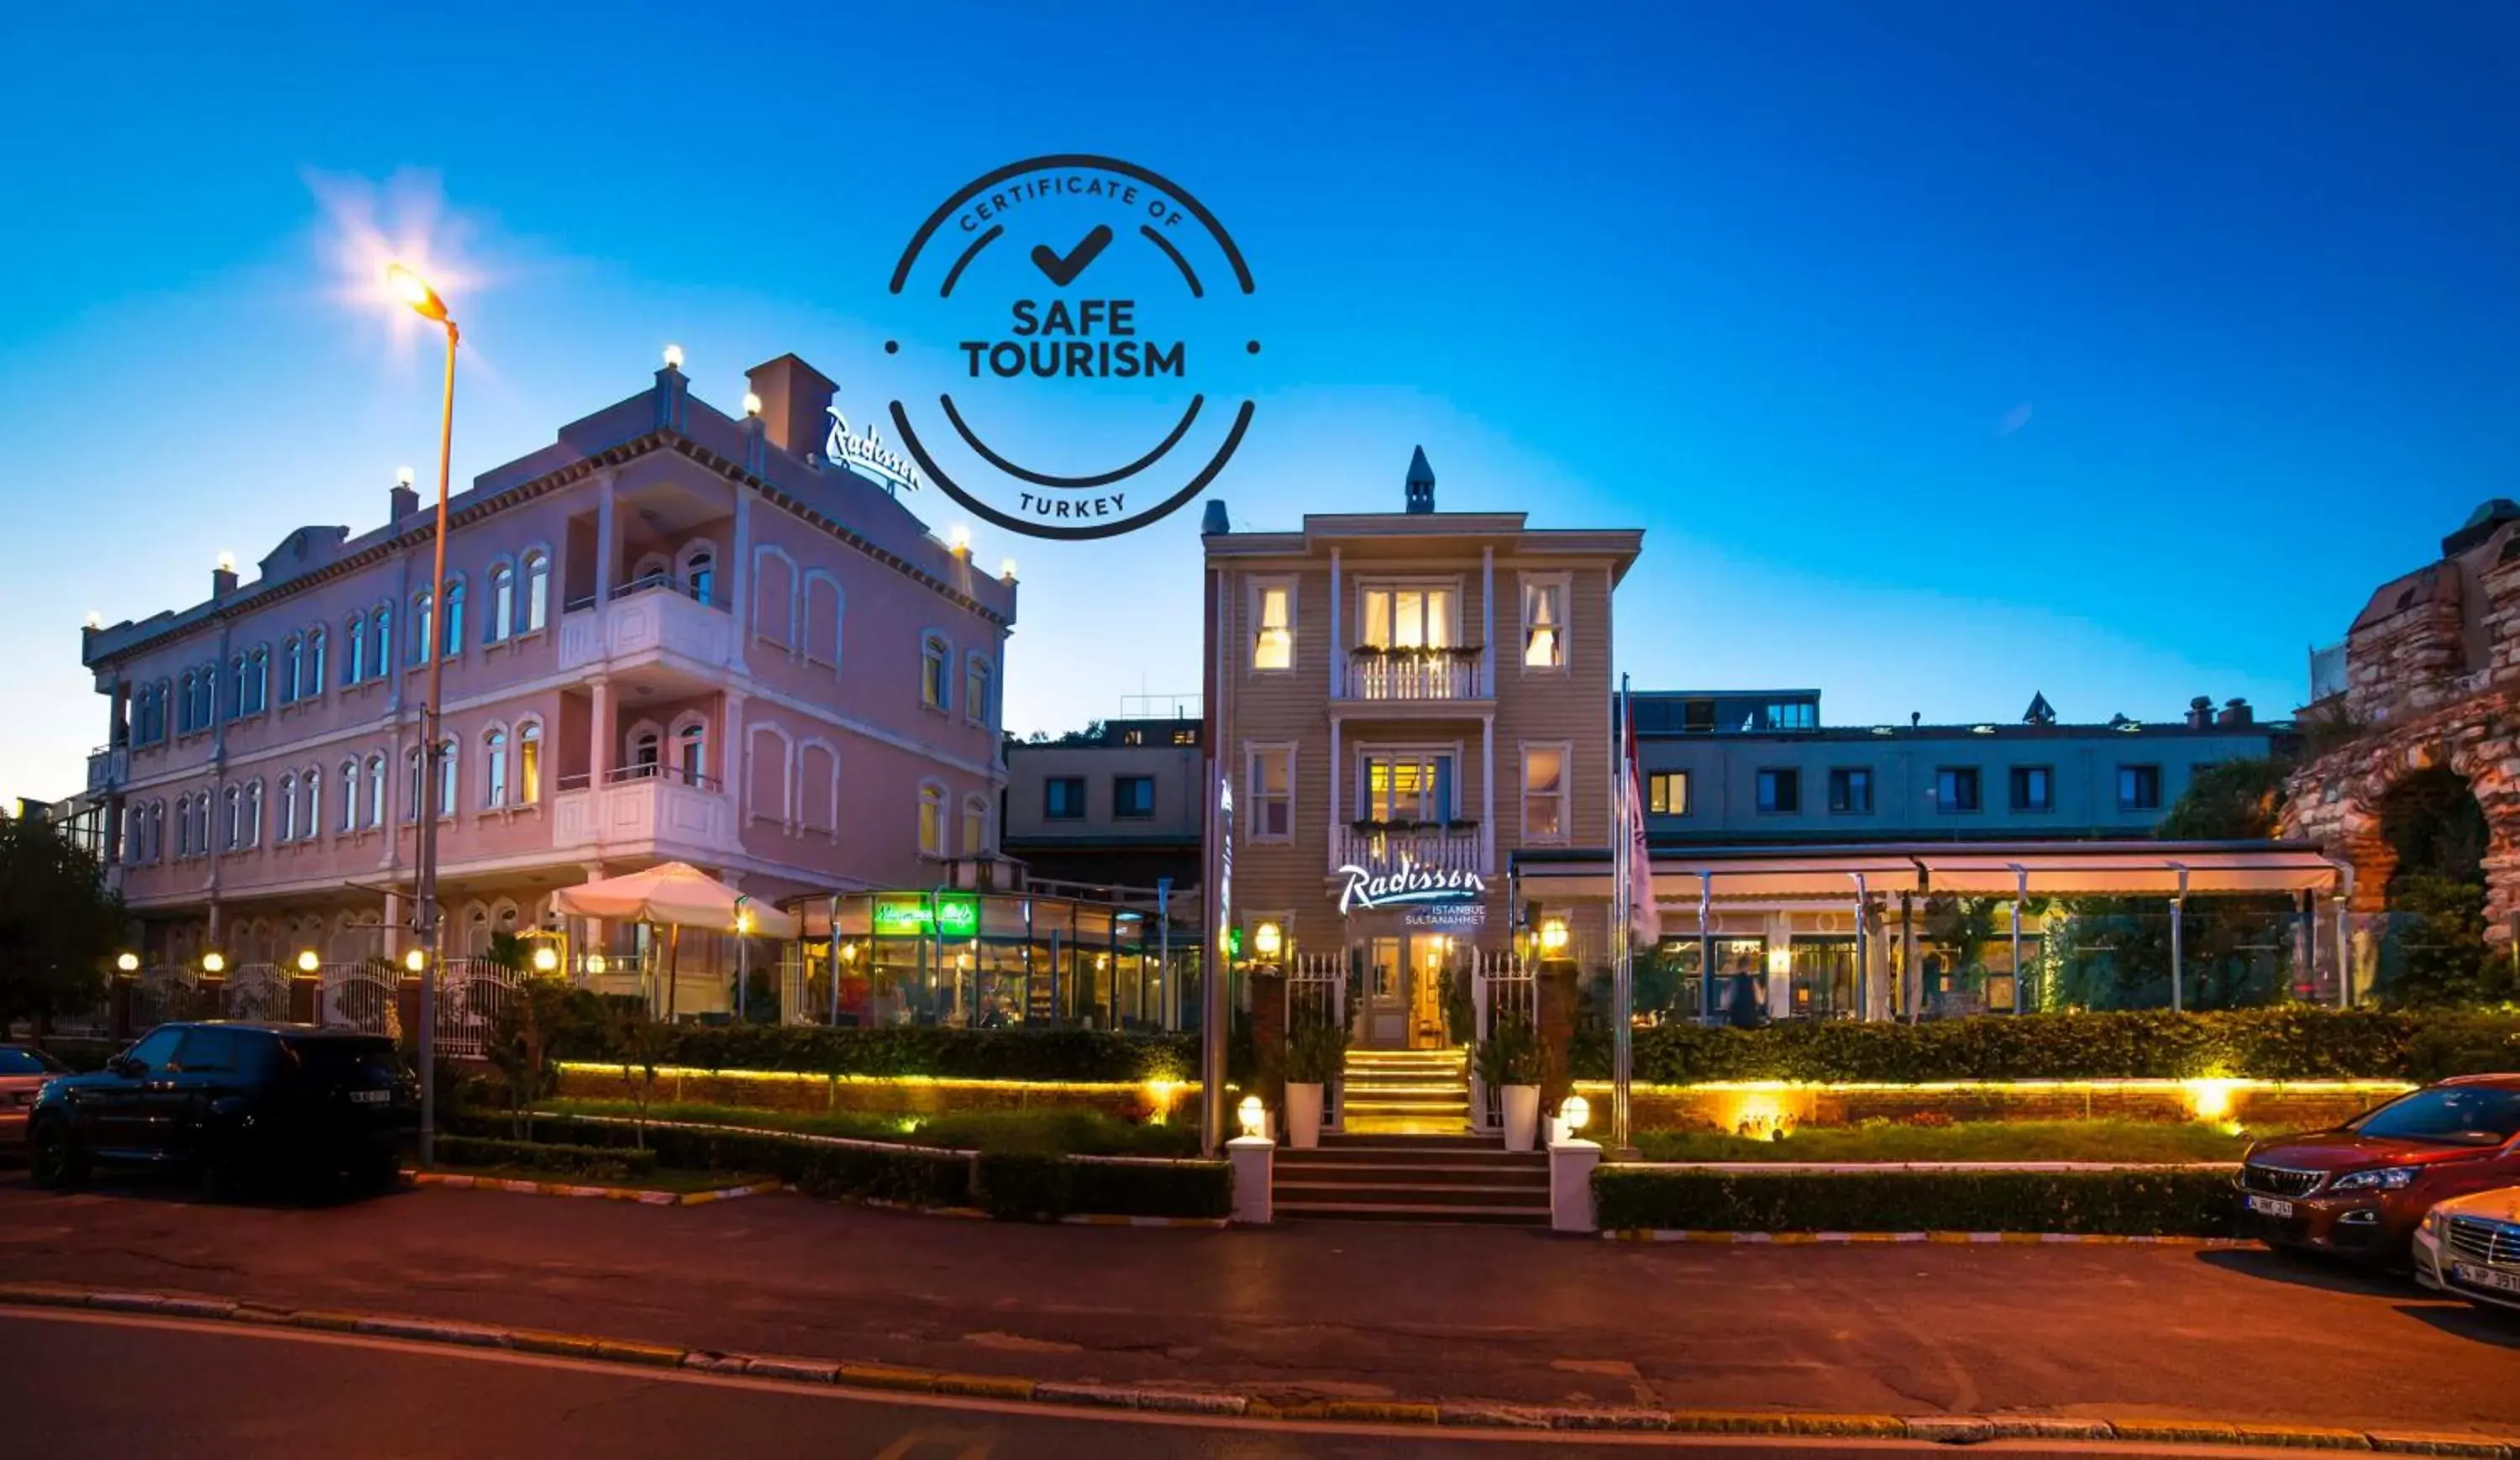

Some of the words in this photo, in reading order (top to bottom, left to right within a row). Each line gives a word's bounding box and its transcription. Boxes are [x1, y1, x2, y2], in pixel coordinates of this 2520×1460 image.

[826, 406, 921, 491] Radisson
[1338, 852, 1485, 914] Radisson
[1404, 915, 1486, 925] SULTANAHMET
[1431, 906, 1486, 915] ISTANBUL
